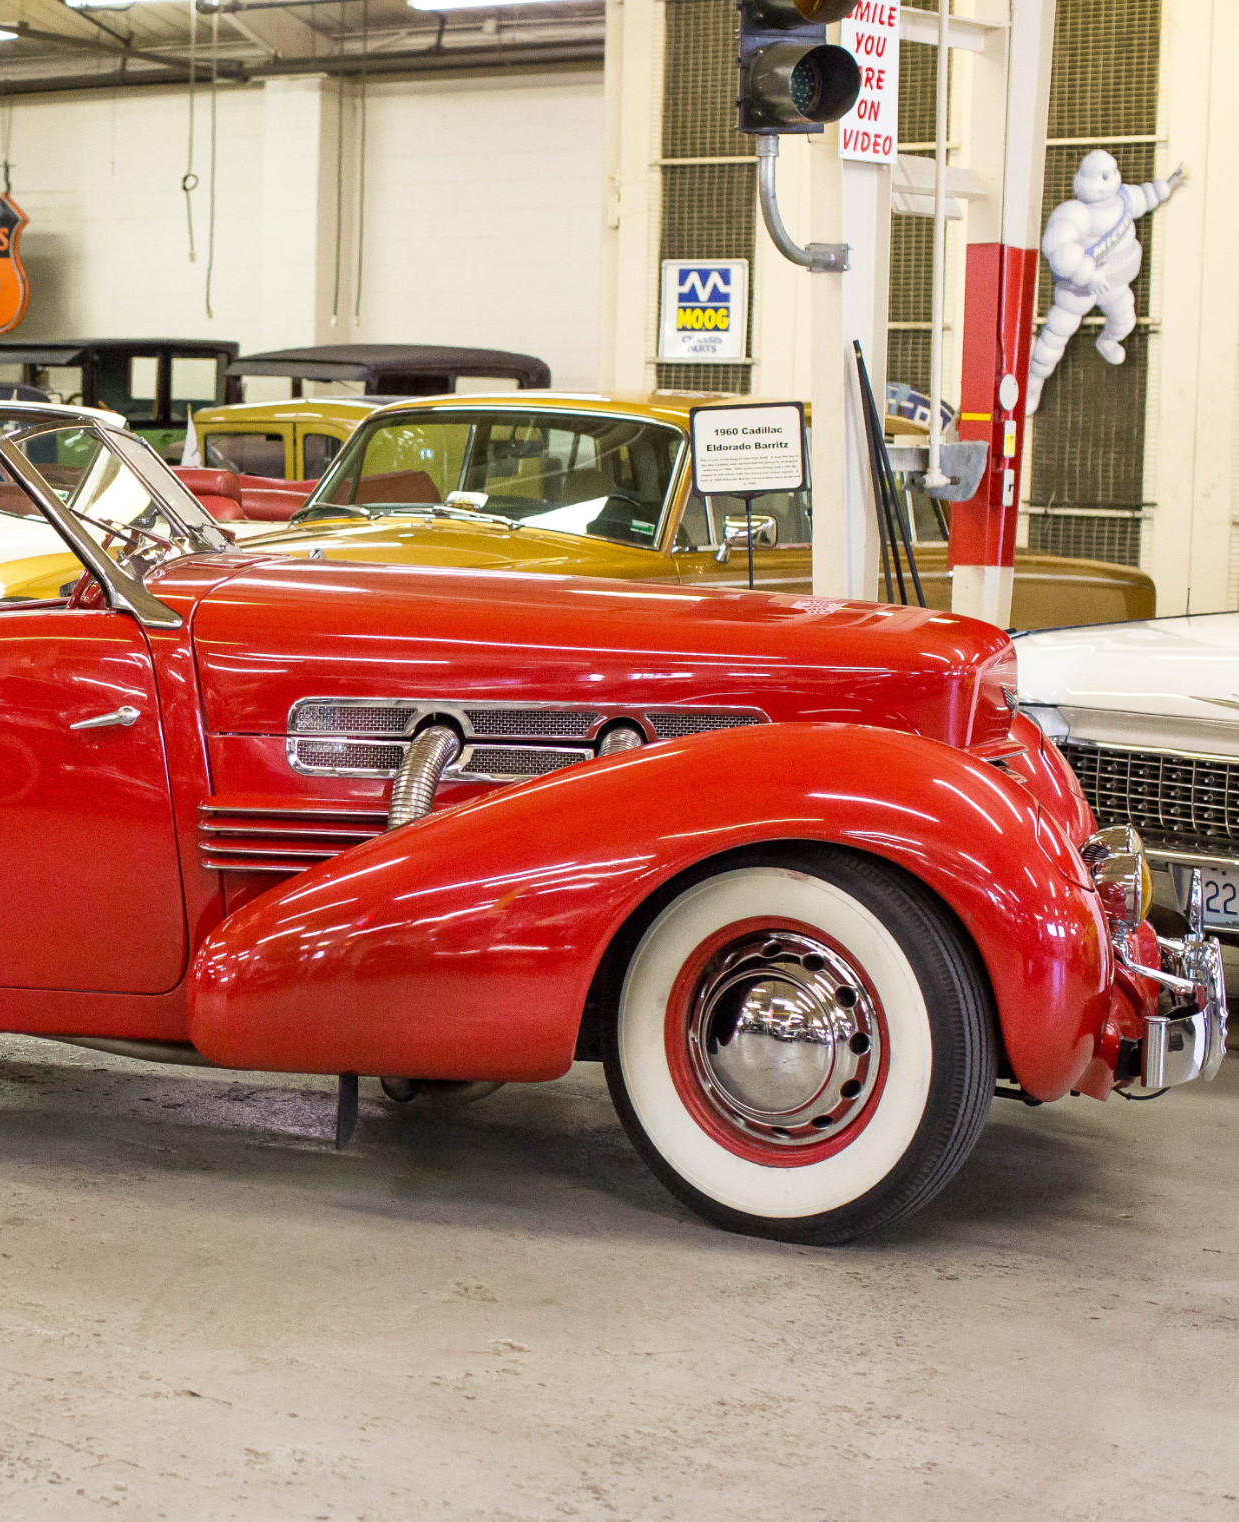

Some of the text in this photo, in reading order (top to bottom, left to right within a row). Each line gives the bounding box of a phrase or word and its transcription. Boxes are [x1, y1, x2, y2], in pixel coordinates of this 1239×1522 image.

[845, 0, 897, 27] MILE
[855, 32, 887, 58] YOU
[857, 99, 881, 122] ON
[843, 128, 893, 156] VIDEO
[677, 308, 729, 330] MOOG
[714, 426, 783, 436] 1960 Cadillac
[706, 441, 789, 452] Eldorado Barritz
